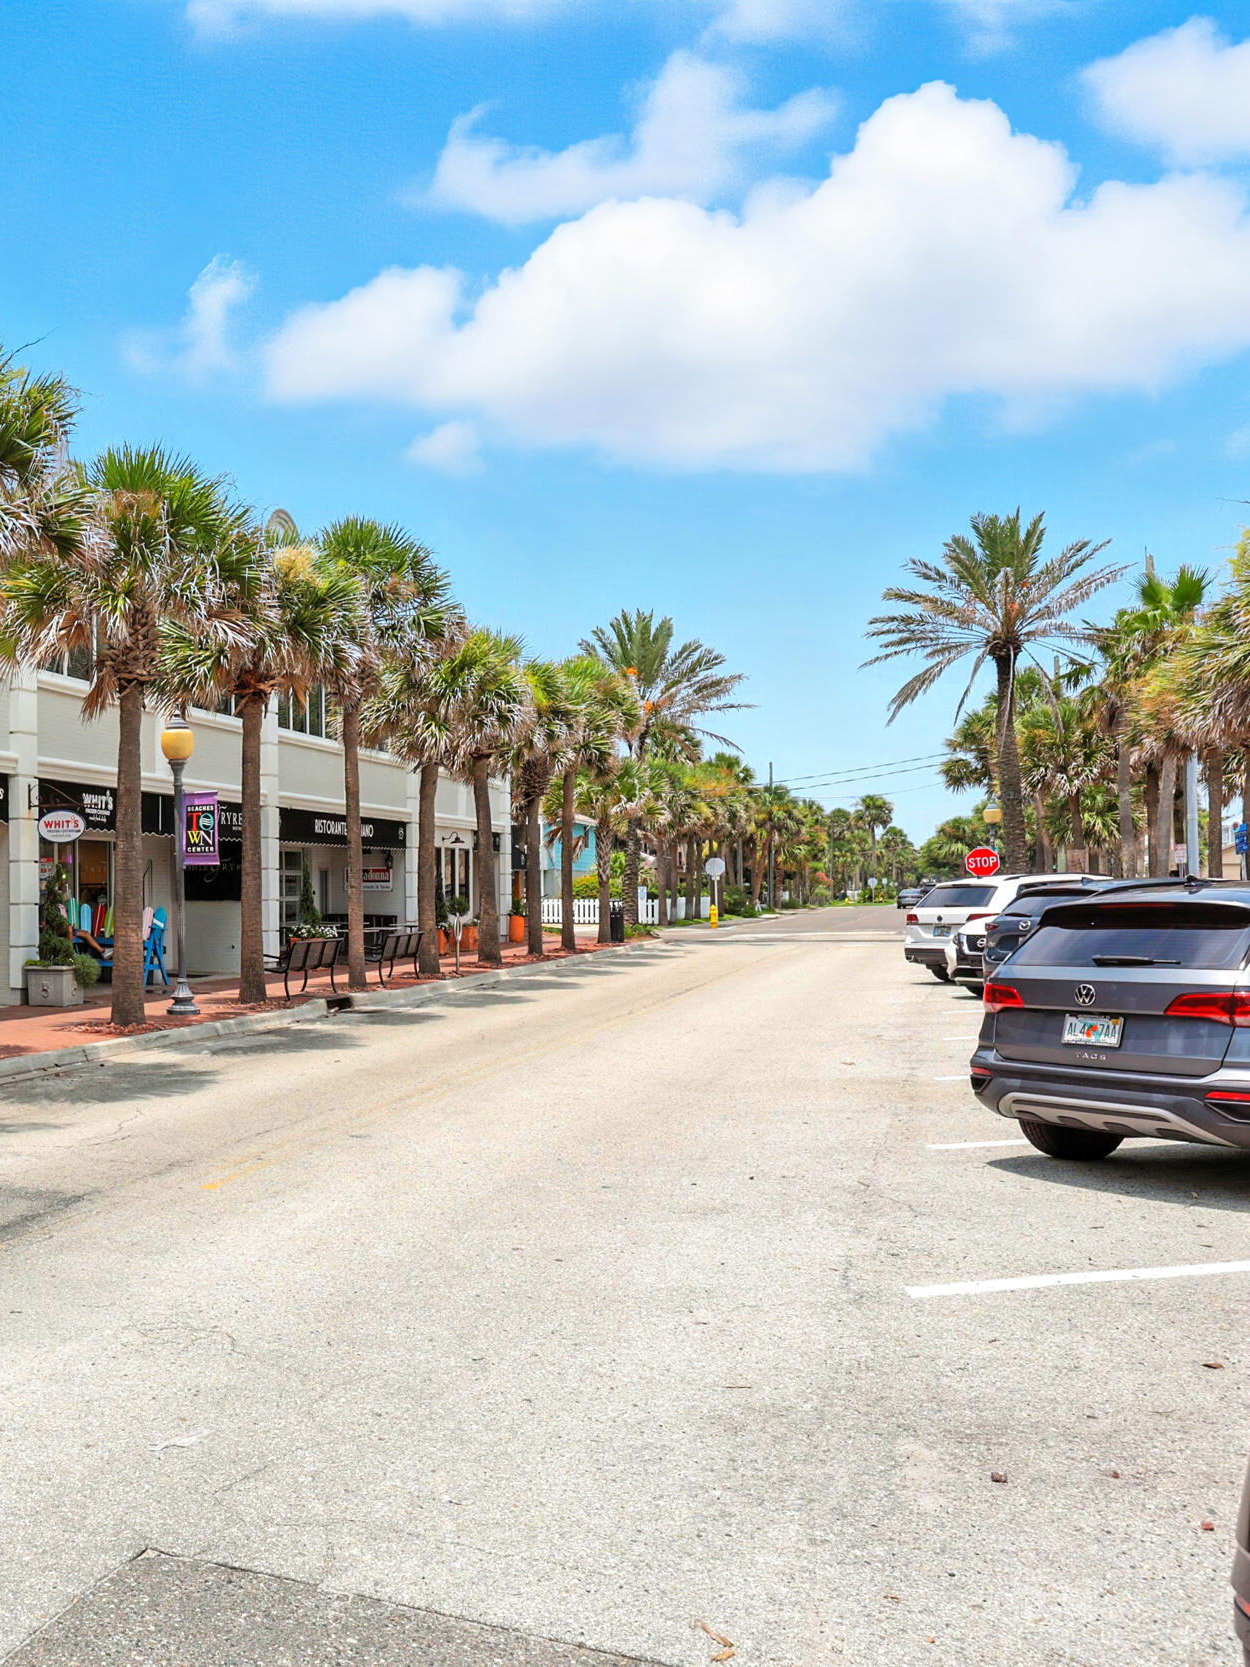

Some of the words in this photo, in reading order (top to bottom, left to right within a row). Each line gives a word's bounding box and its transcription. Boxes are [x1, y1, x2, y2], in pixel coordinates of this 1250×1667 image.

[82, 789, 113, 811] WHIT'S
[43, 815, 79, 829] WHIT'S
[314, 819, 347, 836] RISTORANTE
[361, 824, 374, 838] IANO
[968, 856, 997, 868] STOP
[363, 870, 390, 881] adonna
